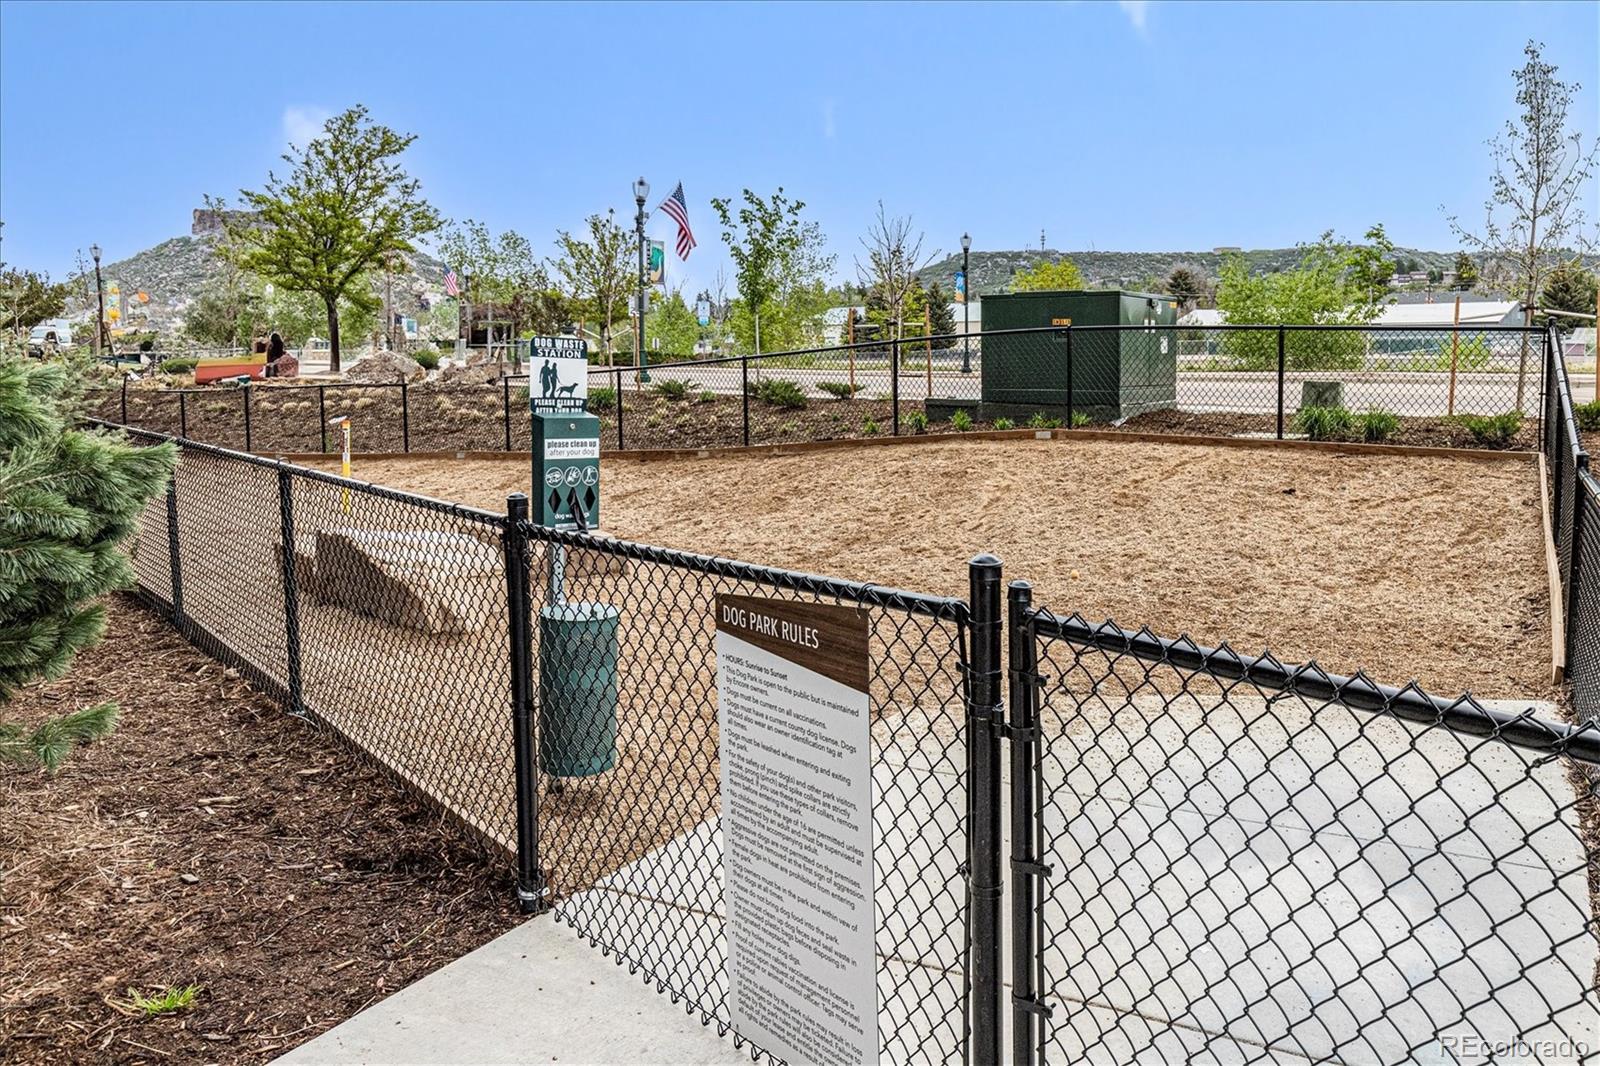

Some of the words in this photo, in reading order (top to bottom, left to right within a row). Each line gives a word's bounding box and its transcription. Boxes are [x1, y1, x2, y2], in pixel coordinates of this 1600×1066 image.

[534, 338, 552, 347] DOG
[555, 339, 584, 350] WASTE
[537, 349, 581, 358] STATION
[582, 448, 595, 456] dog
[723, 605, 746, 628] DOG
[750, 612, 778, 638] PARK
[782, 621, 819, 649] RULES
[745, 660, 763, 672] Sunrise
[770, 668, 788, 681] Sunset
[726, 665, 736, 675] This
[747, 672, 758, 683] Park
[763, 679, 776, 689] open
[793, 689, 810, 701] public
[827, 701, 859, 718] maintained
[732, 677, 750, 689] Encore
[749, 684, 768, 696] owners.
[726, 686, 739, 698] Dogs
[739, 692, 752, 702] must
[759, 700, 778, 712] current
[793, 712, 826, 730] vaccinations.
[727, 698, 740, 710] Dogs
[740, 704, 752, 714] must
[753, 708, 764, 719] have
[769, 715, 787, 728] current
[788, 722, 806, 736] county
[819, 732, 839, 747] license.
[840, 741, 856, 754] Dogs
